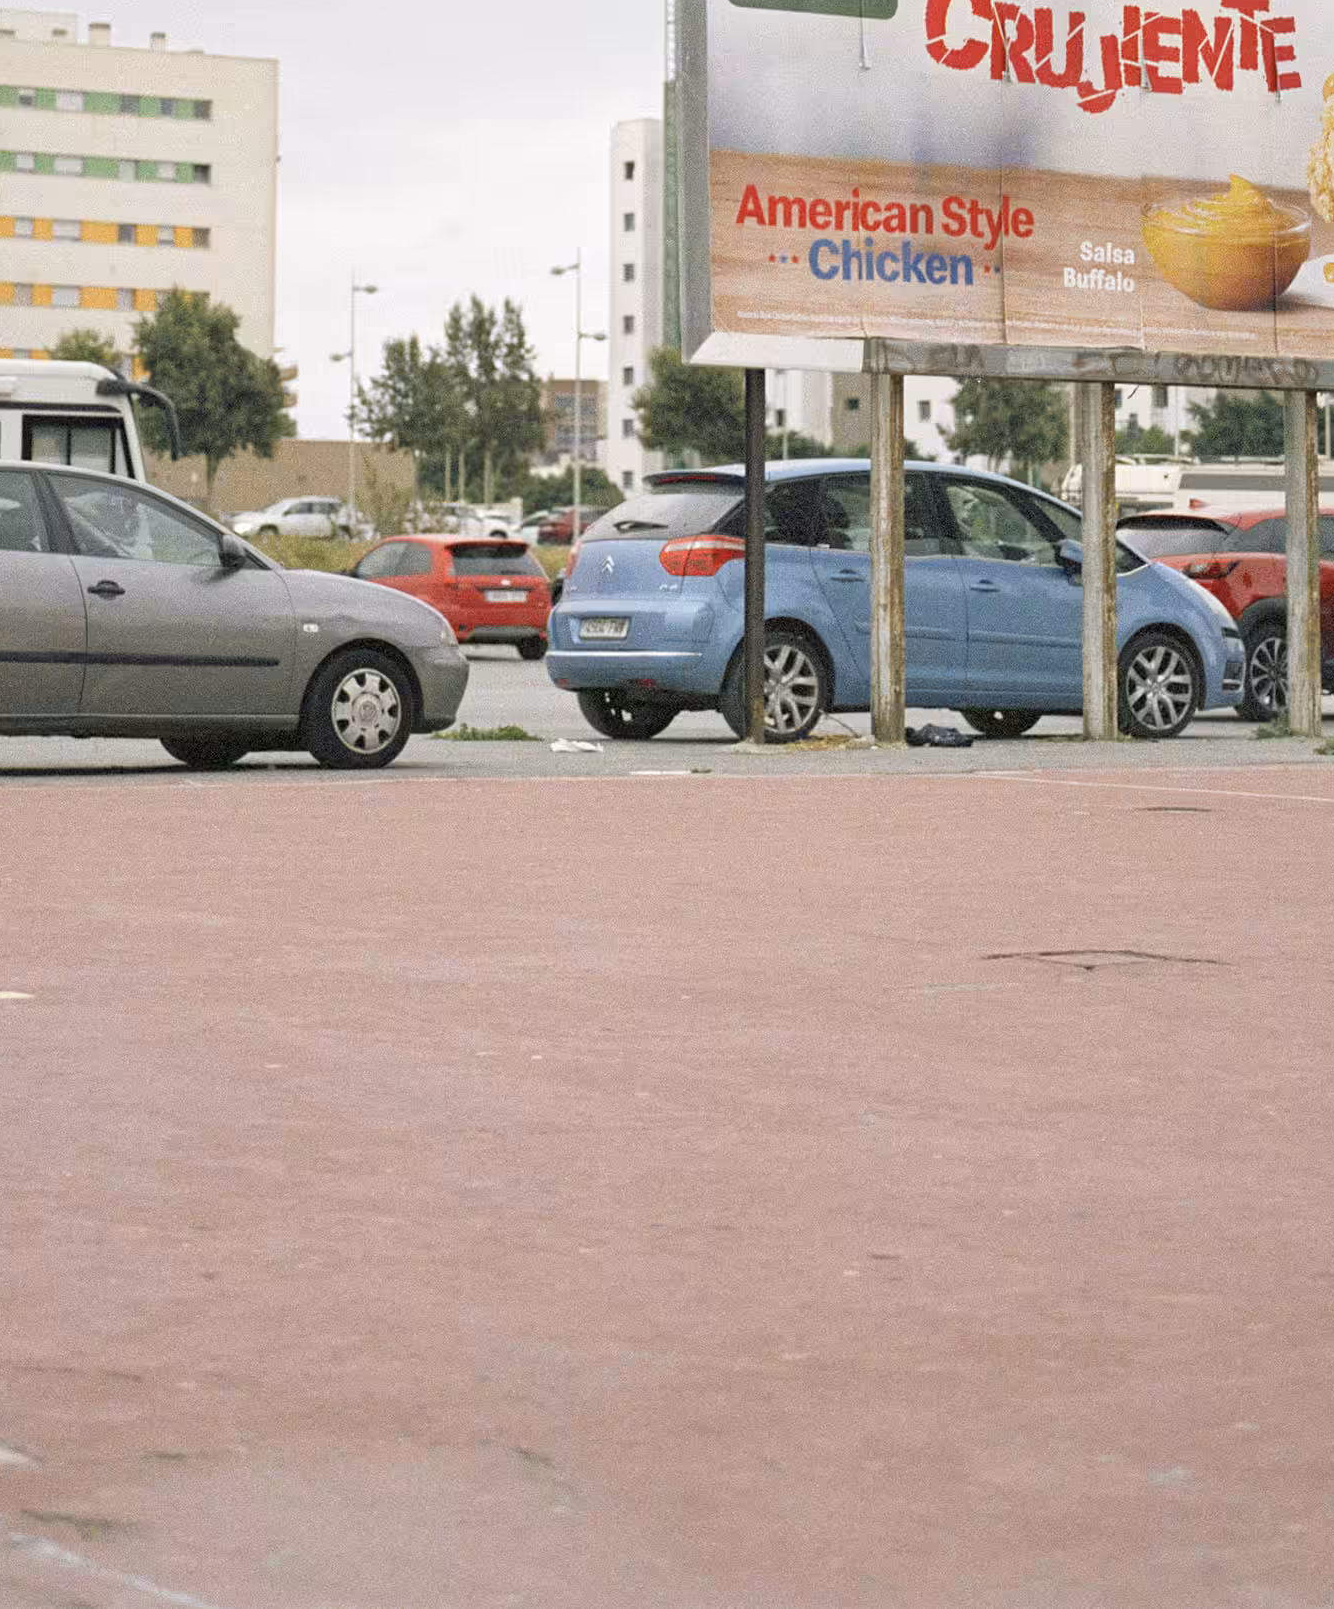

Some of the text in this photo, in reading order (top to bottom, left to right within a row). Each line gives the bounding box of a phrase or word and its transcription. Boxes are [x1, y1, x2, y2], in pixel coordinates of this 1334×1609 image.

[736, 184, 1034, 250] American Style
[809, 237, 973, 285] Chicken
[1080, 240, 1135, 265] Salsa
[1063, 267, 1135, 293] Buffalo
